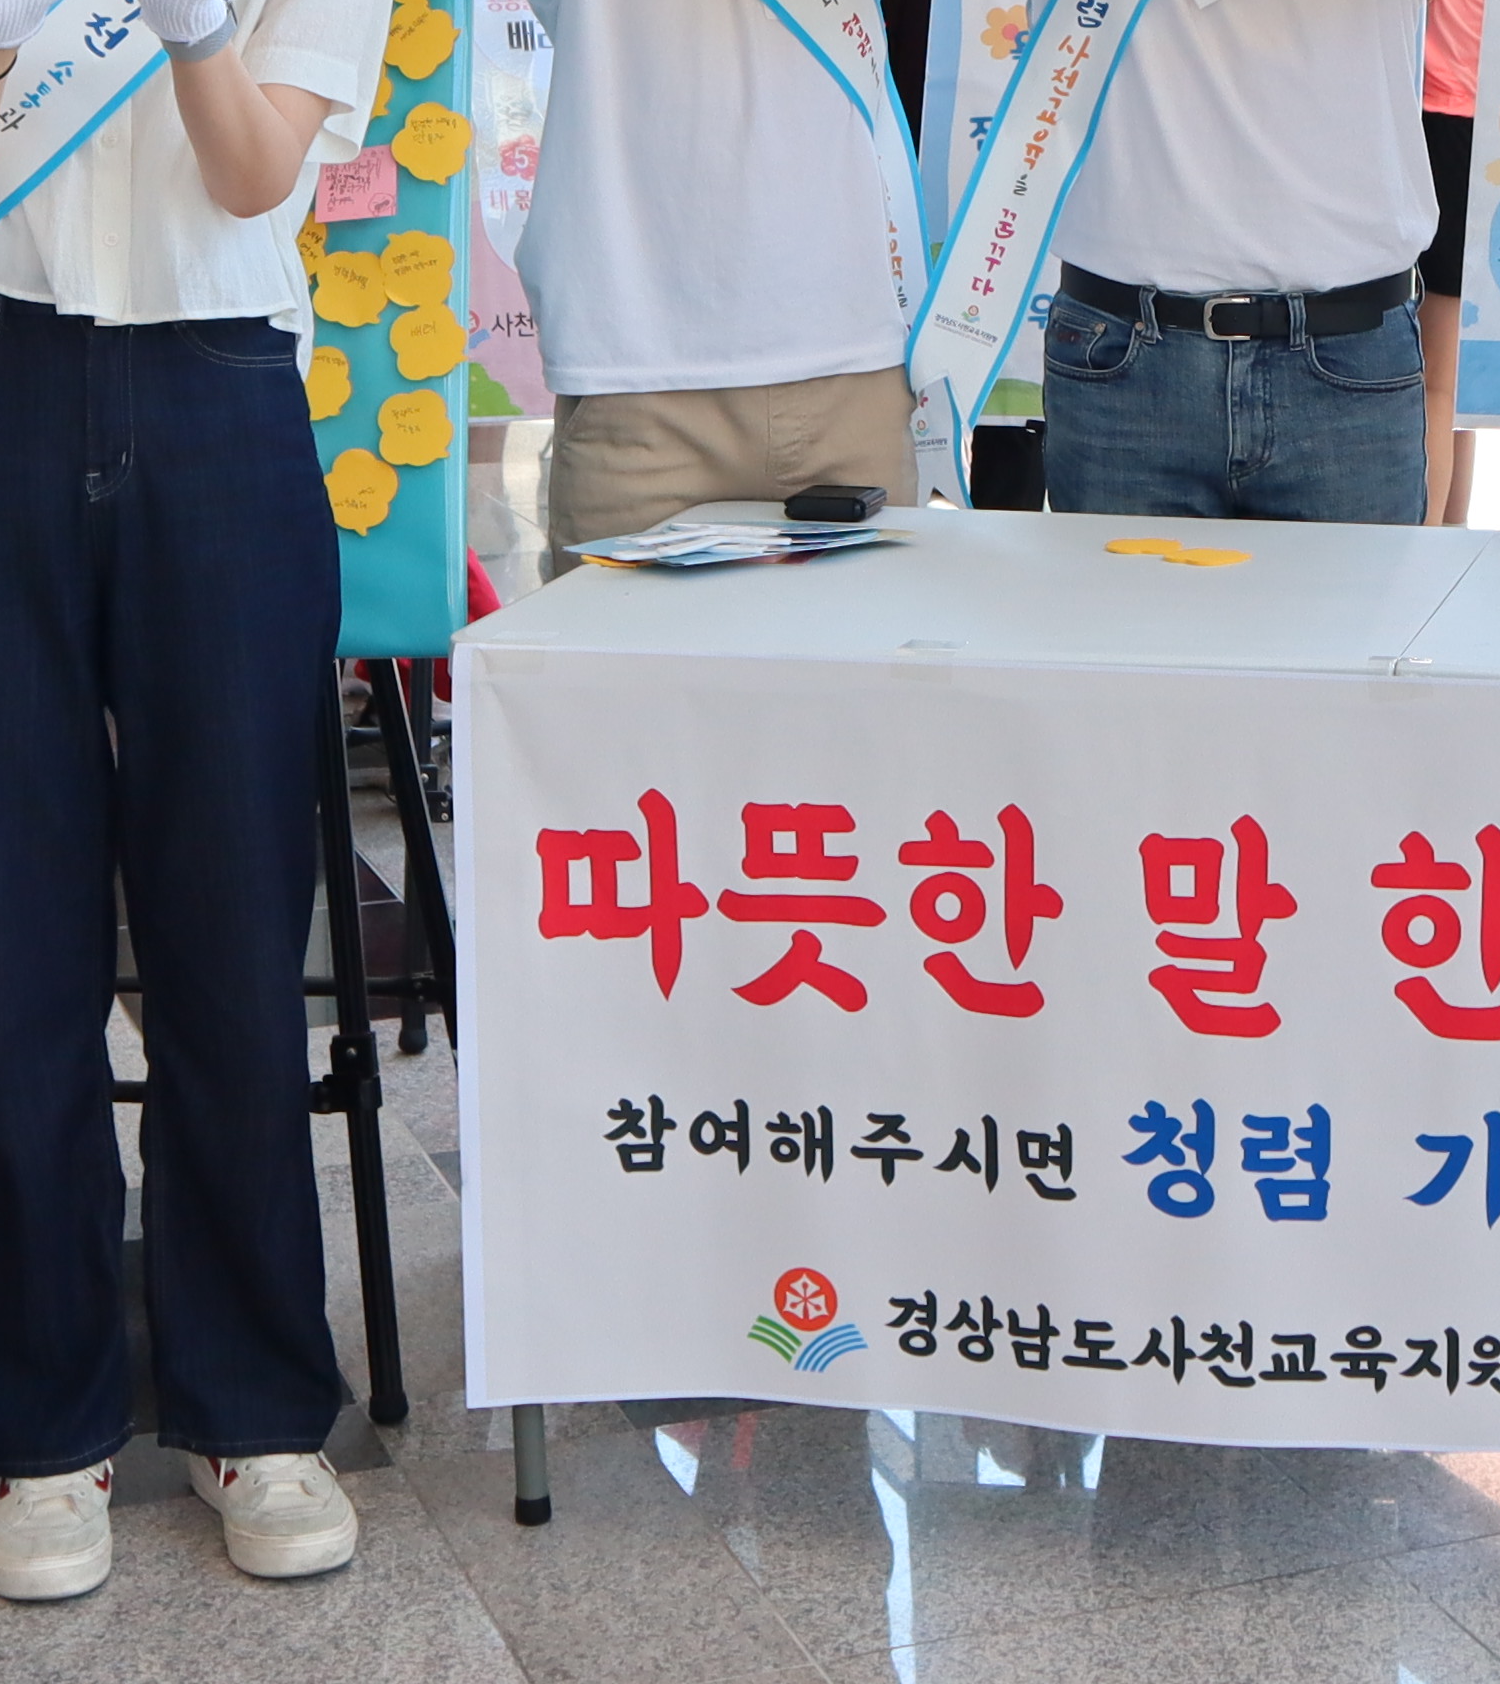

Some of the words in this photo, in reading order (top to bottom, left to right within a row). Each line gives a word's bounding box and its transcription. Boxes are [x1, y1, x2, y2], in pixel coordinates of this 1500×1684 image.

[514, 146, 529, 168] 5
[1013, 34, 1092, 197] 사천교육을
[971, 208, 1018, 297] 꿈꾸다
[490, 311, 535, 339] 사천
[536, 788, 1064, 1018] 따뜻한
[1138, 814, 1298, 1039] 말
[604, 1094, 1077, 1201] 참여해주시면
[1123, 1098, 1331, 1221] 청렴
